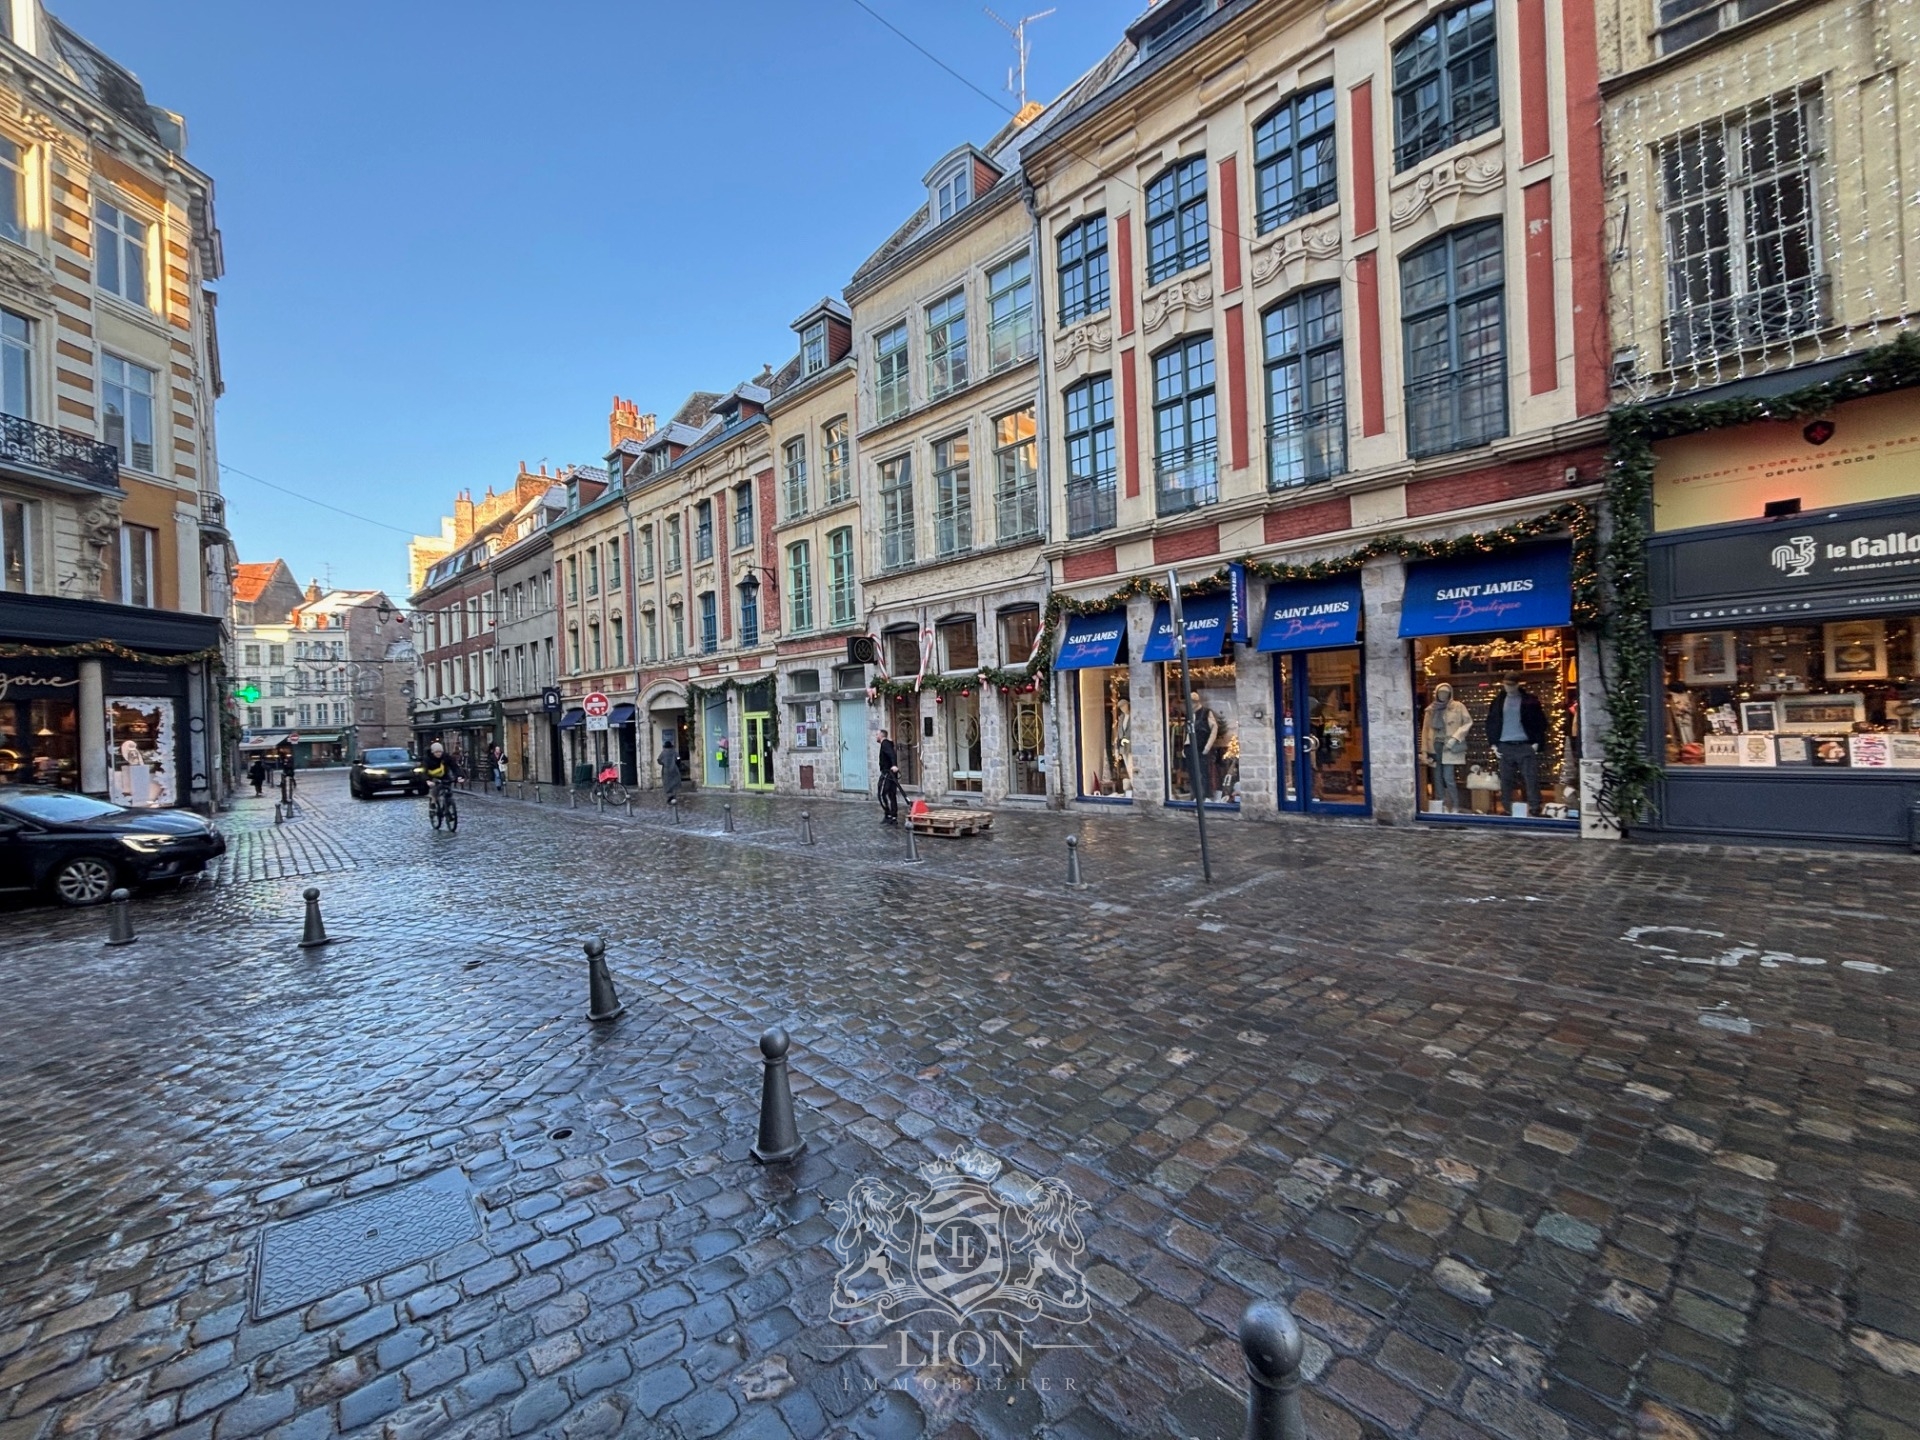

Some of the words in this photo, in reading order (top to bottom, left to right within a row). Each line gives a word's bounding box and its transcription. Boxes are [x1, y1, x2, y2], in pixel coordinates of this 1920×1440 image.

[1672, 468, 1740, 484] CONCEPT
[1747, 458, 1799, 471] STORE
[1765, 463, 1824, 478] DEPUIS
[1826, 543, 1847, 559] le
[1833, 561, 1892, 572] FABRIQUE
[1894, 559, 1911, 567] DE
[1230, 571, 1238, 603] JAMES
[1436, 585, 1481, 601] SAINT
[1481, 579, 1534, 596] JAMES
[1231, 603, 1239, 634] SAINT
[1273, 606, 1310, 620] SAINT
[1309, 601, 1350, 616] JAMES
[1433, 599, 1522, 623] Boutique
[1187, 617, 1220, 631] JAMES
[1270, 618, 1340, 640] Boutique
[1068, 634, 1093, 645] SAINT
[1091, 630, 1119, 642] JAMES
